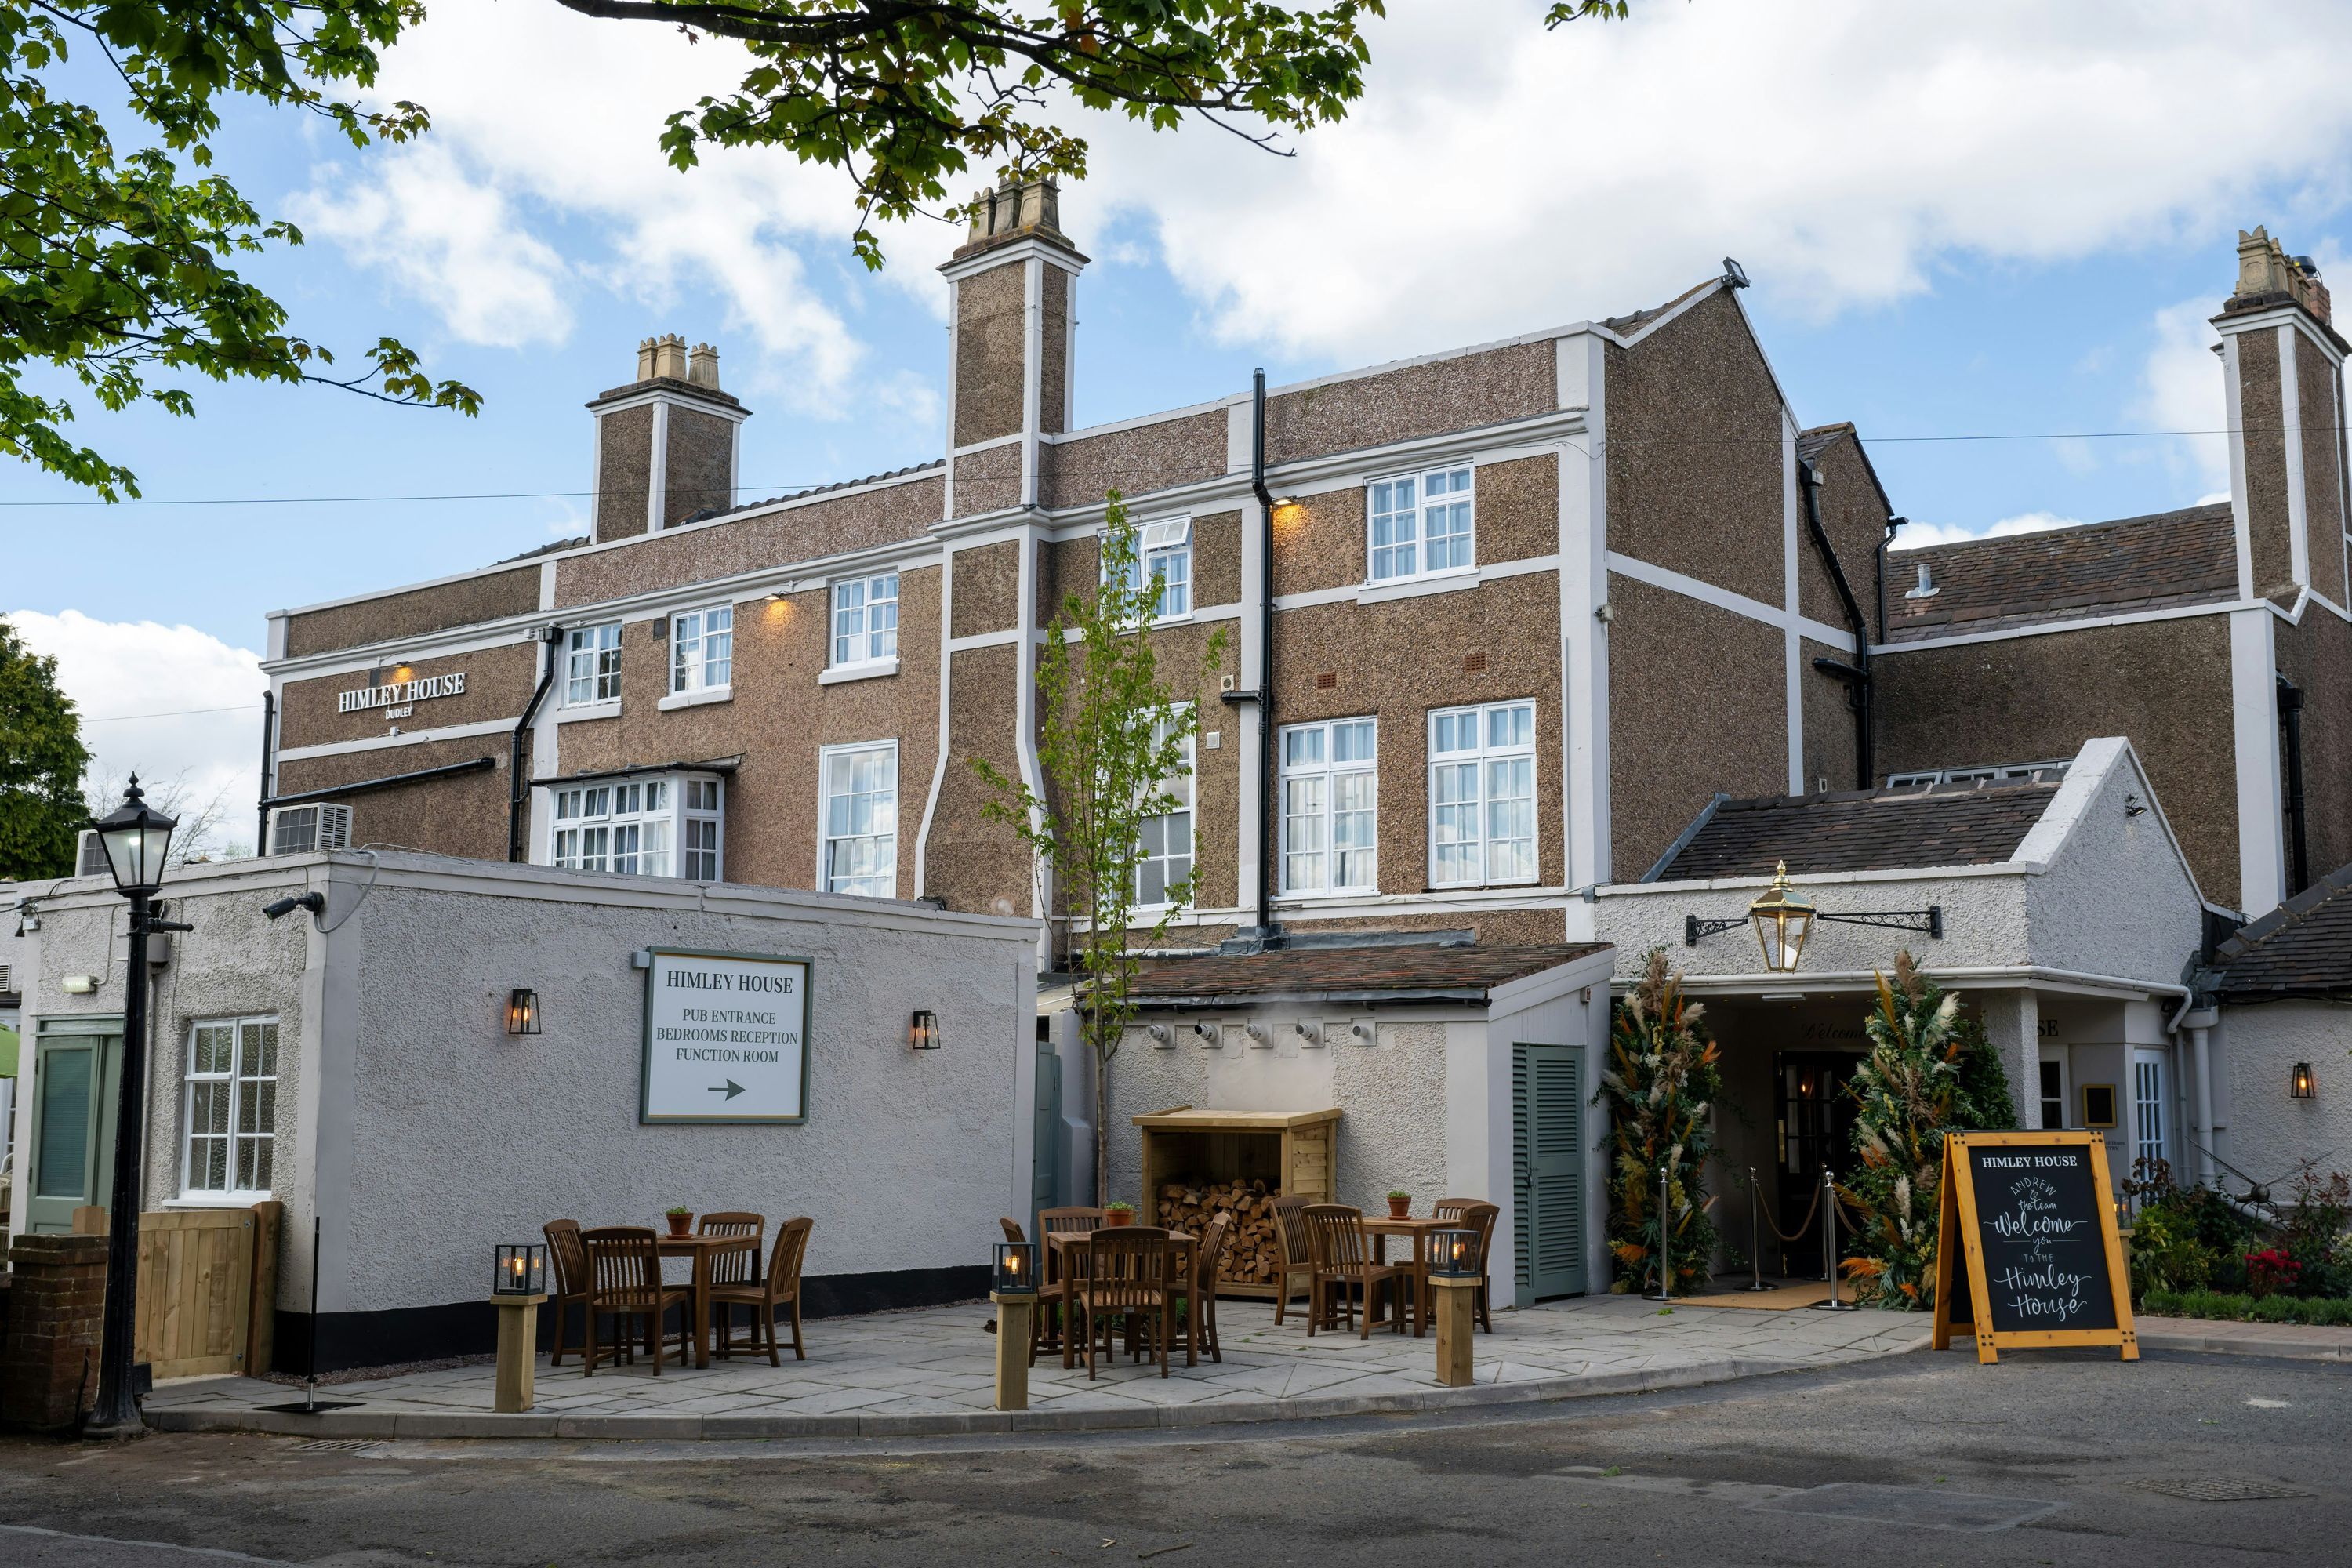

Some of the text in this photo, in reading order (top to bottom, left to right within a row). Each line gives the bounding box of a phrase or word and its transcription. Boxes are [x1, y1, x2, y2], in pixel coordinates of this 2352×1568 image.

[339, 673, 466, 713] HIMLEY HOUSE
[386, 706, 412, 720] DUDLEY
[666, 971, 793, 993] HIMLEY HOUSE
[683, 1008, 776, 1025] PUB ENTRANCE
[657, 1028, 798, 1044] BEDROOMS RECEPTION
[676, 1048, 779, 1063] FUNCTION ROOM
[1982, 1156, 2078, 1168] HIMLEY HOUSE
[2010, 1177, 2056, 1196] ANDREW
[2018, 1199, 2057, 1211] the team
[1984, 1210, 2088, 1236] Welcome
[2033, 1236, 2053, 1254] you
[2035, 1254, 2055, 1262] THE
[1994, 1264, 2092, 1297] Himley
[2008, 1294, 2087, 1322] House
